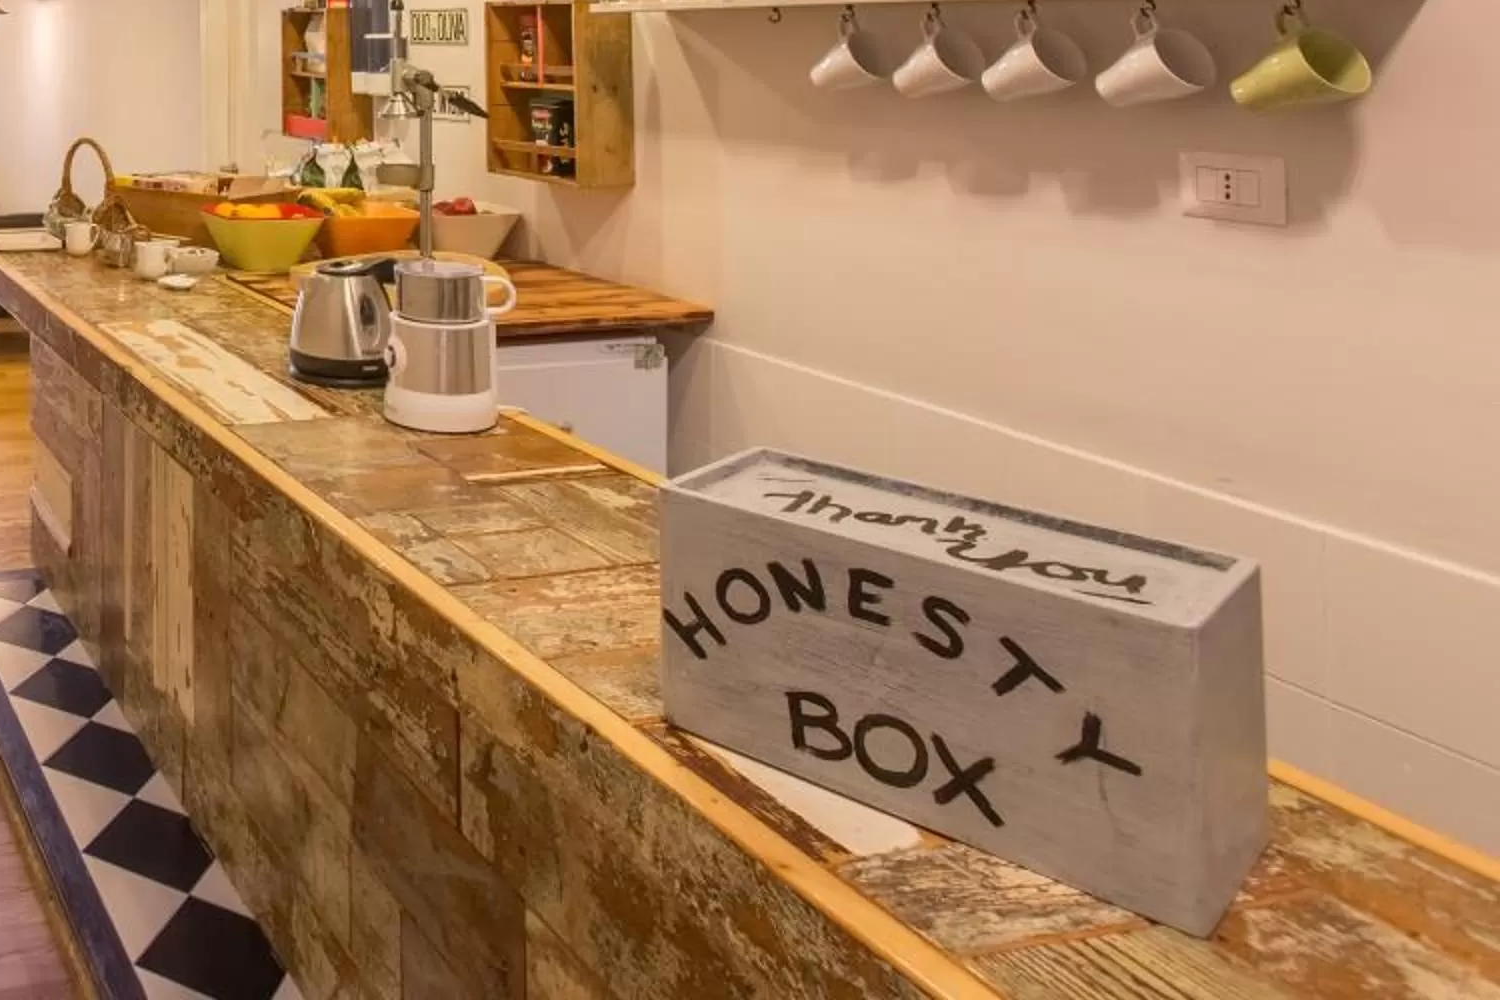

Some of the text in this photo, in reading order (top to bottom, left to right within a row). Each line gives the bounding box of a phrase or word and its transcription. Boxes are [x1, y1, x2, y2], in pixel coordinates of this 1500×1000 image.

[763, 488, 989, 543] Thank
[664, 557, 1142, 778] HONESTY
[784, 690, 1005, 828] BOX
